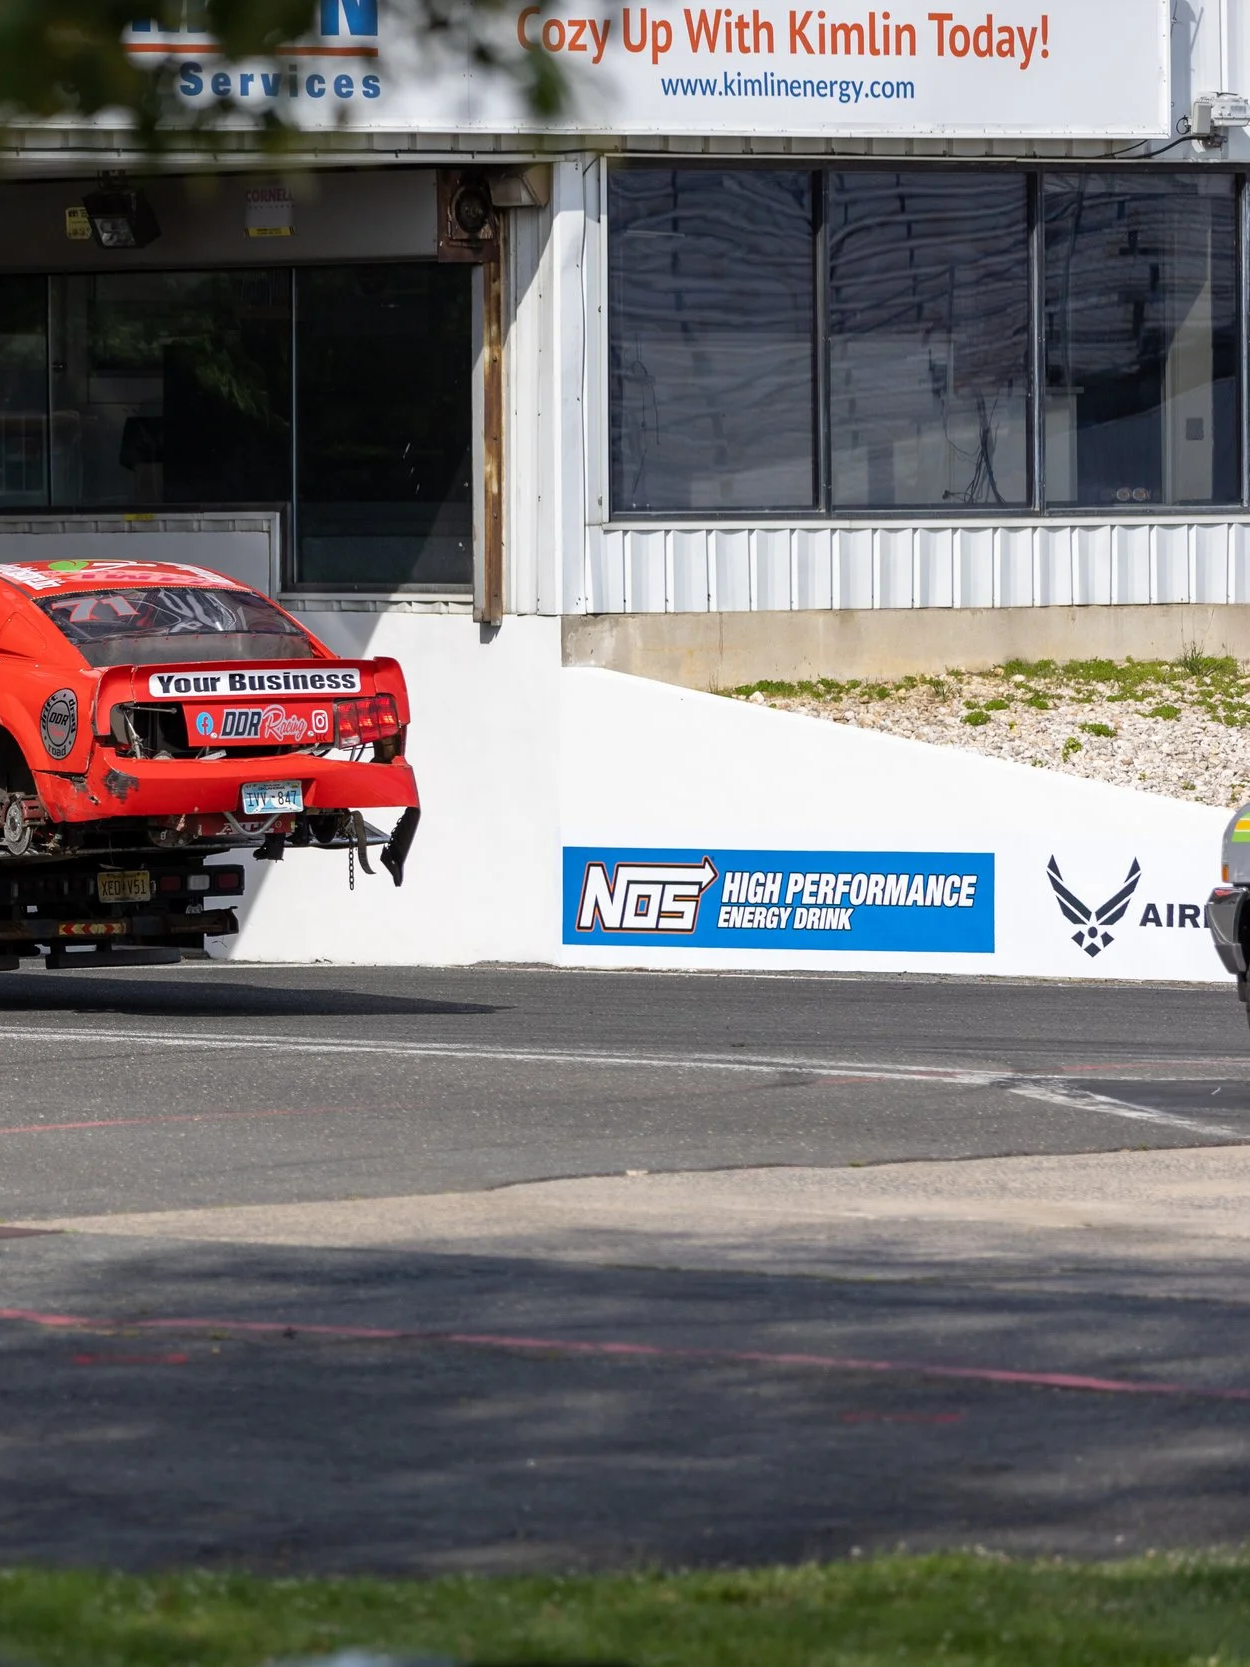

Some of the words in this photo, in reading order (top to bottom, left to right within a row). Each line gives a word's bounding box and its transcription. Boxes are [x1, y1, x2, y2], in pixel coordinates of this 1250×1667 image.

[517, 7, 608, 64] Cozy
[622, 8, 673, 64] Up
[684, 8, 774, 55] With
[787, 9, 917, 57] Kimlin
[928, 13, 1051, 69] Today!
[179, 61, 381, 98] Services
[661, 71, 916, 102] www.kimlinenergy.com
[156, 673, 221, 694] Your
[229, 671, 357, 693] Business
[49, 712, 69, 726] DDR
[220, 709, 262, 738] DDR
[262, 704, 308, 742] Racing
[576, 857, 717, 934] NOS
[722, 871, 781, 904] HIGH
[786, 873, 977, 907] PERFORMANCE
[717, 906, 791, 930] ENERGY
[793, 907, 852, 931] DRINK
